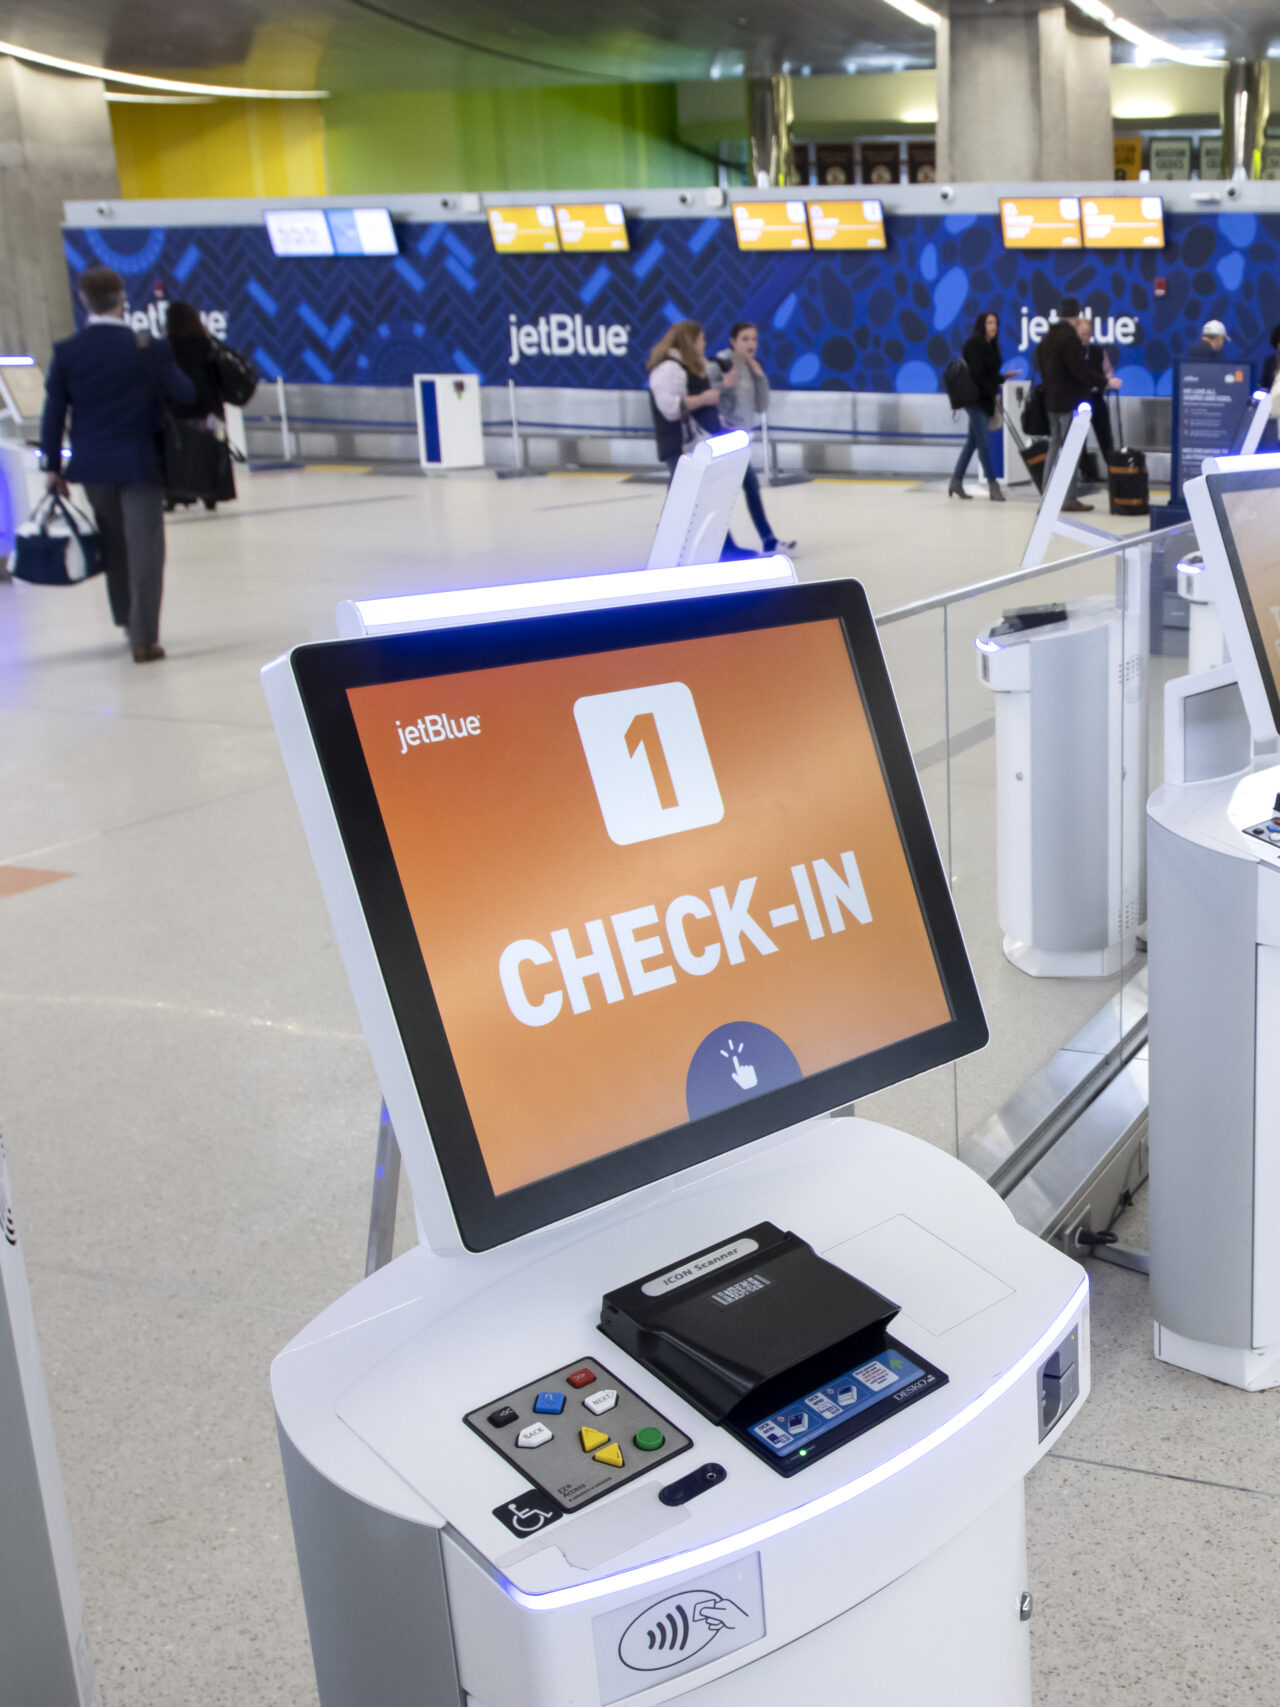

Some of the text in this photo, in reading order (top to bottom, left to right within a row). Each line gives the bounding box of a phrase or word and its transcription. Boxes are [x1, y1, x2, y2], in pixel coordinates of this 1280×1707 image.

[508, 313, 630, 365] jetBlue
[395, 712, 481, 754] jetBlue
[624, 711, 680, 811] 1
[499, 850, 873, 1027] CHECK-IN
[663, 1247, 739, 1286] ICON Scanner
[592, 1393, 613, 1406] NEXT
[893, 1376, 928, 1401] DESKO
[523, 1426, 545, 1440] BACK
